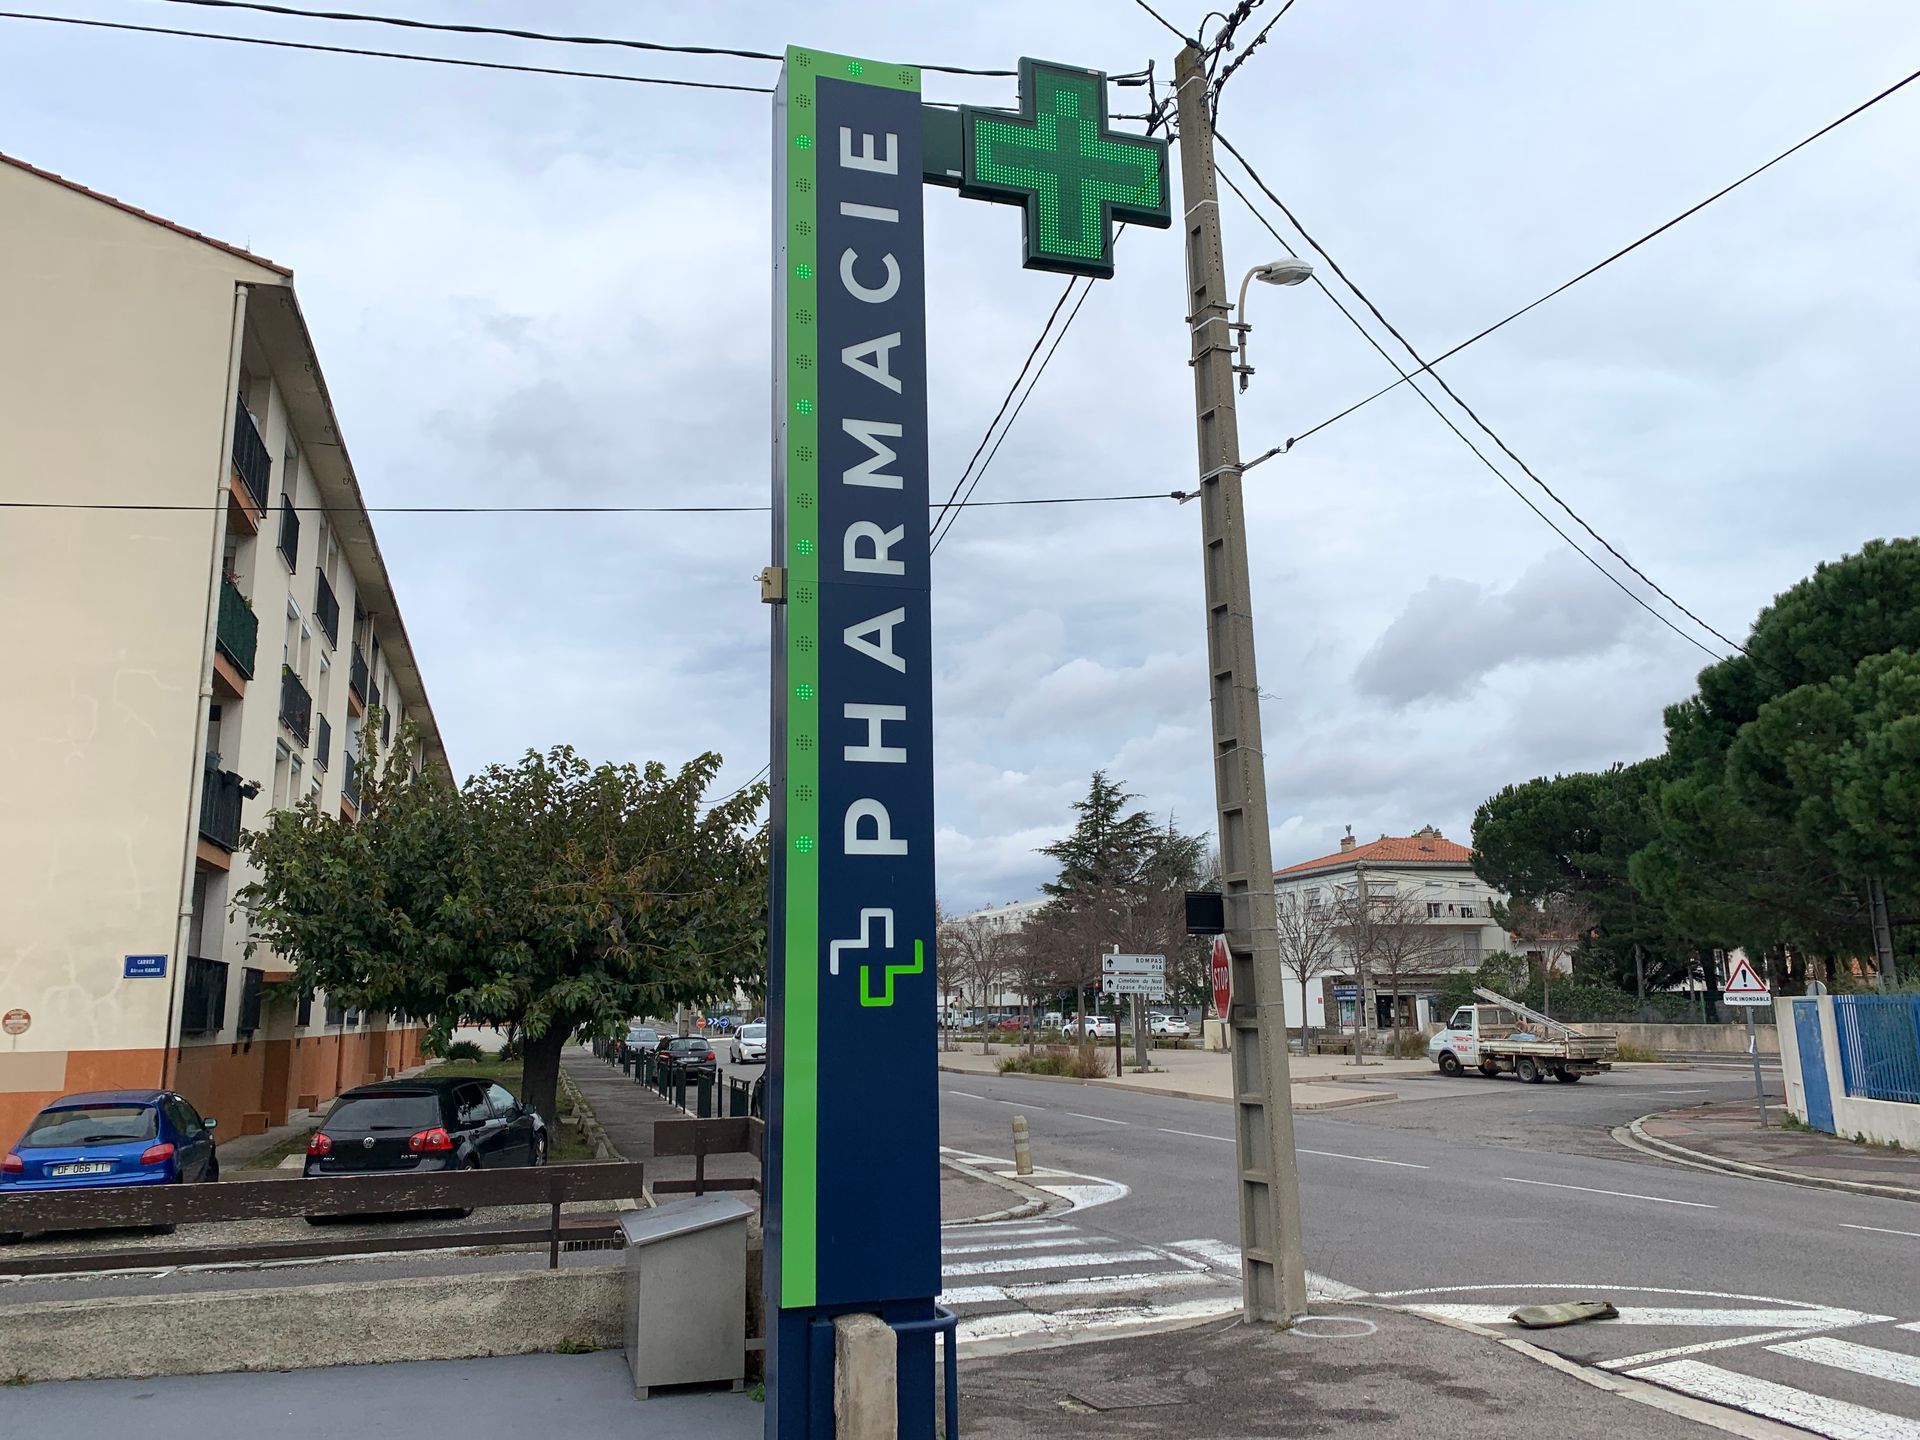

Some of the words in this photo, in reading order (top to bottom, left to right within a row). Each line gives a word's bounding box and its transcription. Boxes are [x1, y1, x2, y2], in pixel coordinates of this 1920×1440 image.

[839, 126, 909, 856] PHARMACIE
[1213, 966, 1229, 991] STOP
[1137, 984, 1163, 992] Polygone
[72, 1164, 91, 1173] 066
